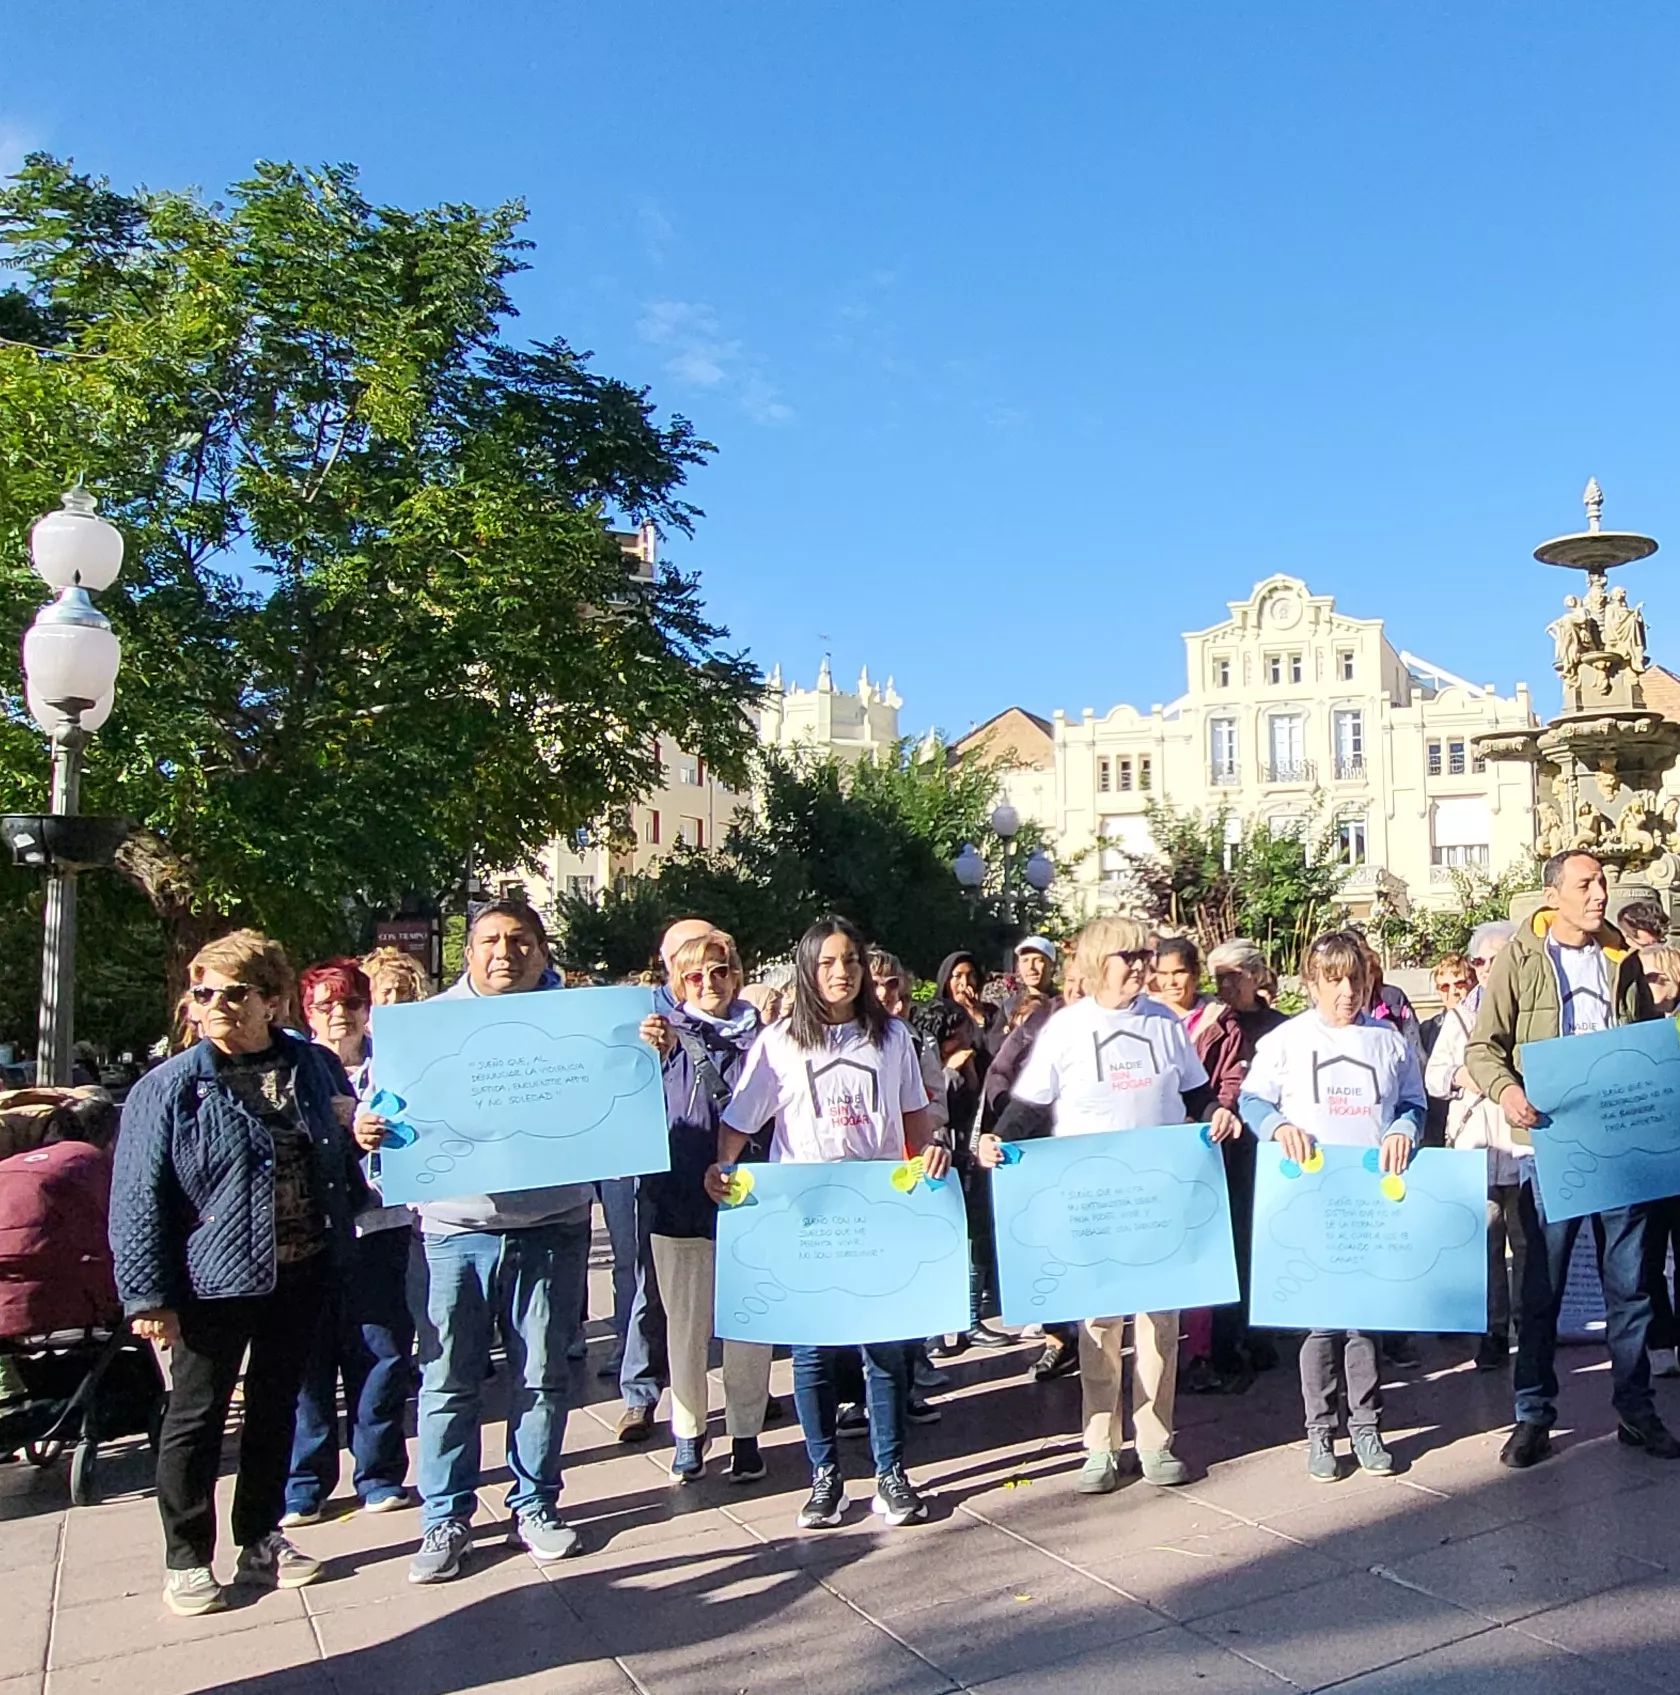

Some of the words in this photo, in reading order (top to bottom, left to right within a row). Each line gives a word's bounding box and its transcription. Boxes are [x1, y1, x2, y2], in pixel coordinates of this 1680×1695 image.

[533, 1055, 548, 1063] AL
[525, 1068, 537, 1076] LA
[540, 1062, 584, 1074] VIOLENCIA
[1110, 1060, 1143, 1071] NADIE
[1111, 1070, 1130, 1081] SIN
[1112, 1077, 1152, 1091] HOGAR
[1327, 1086, 1362, 1097] NADIE
[475, 1099, 482, 1110] Y
[488, 1099, 502, 1108] NO
[827, 1093, 862, 1106] NADIE
[1329, 1096, 1348, 1105] SIN
[830, 1105, 849, 1117] SIN
[1330, 1105, 1371, 1116] HOGAR
[832, 1114, 870, 1128] HOGAR
